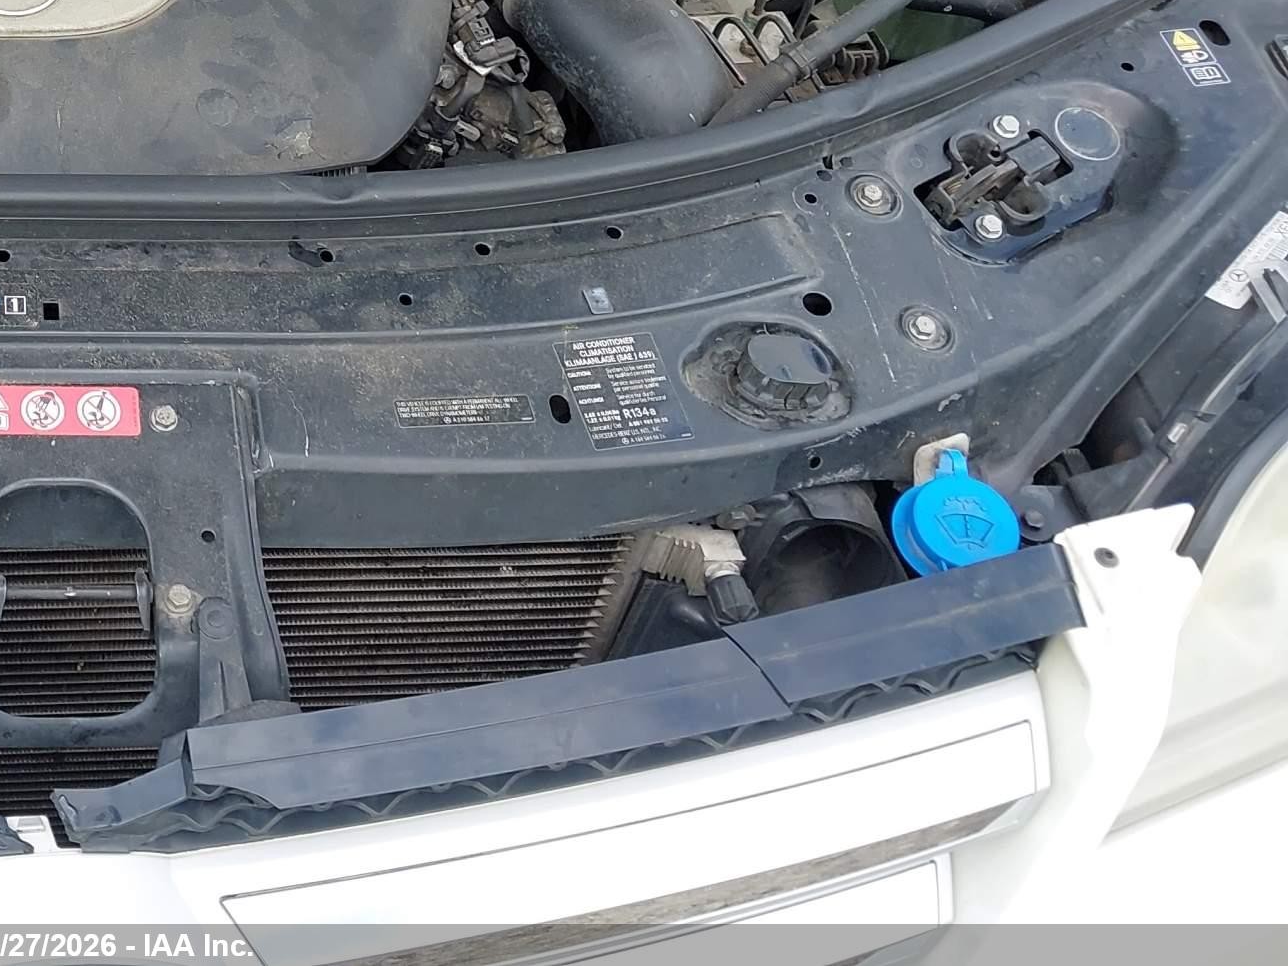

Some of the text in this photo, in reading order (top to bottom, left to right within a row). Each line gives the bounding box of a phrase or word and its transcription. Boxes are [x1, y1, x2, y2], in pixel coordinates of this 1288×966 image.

[572, 336, 635, 351] AIR CONDITIONER
[579, 345, 634, 357] CLIMATISATION
[564, 354, 617, 367] KLIMAANLAGE
[622, 407, 657, 419] R134a
